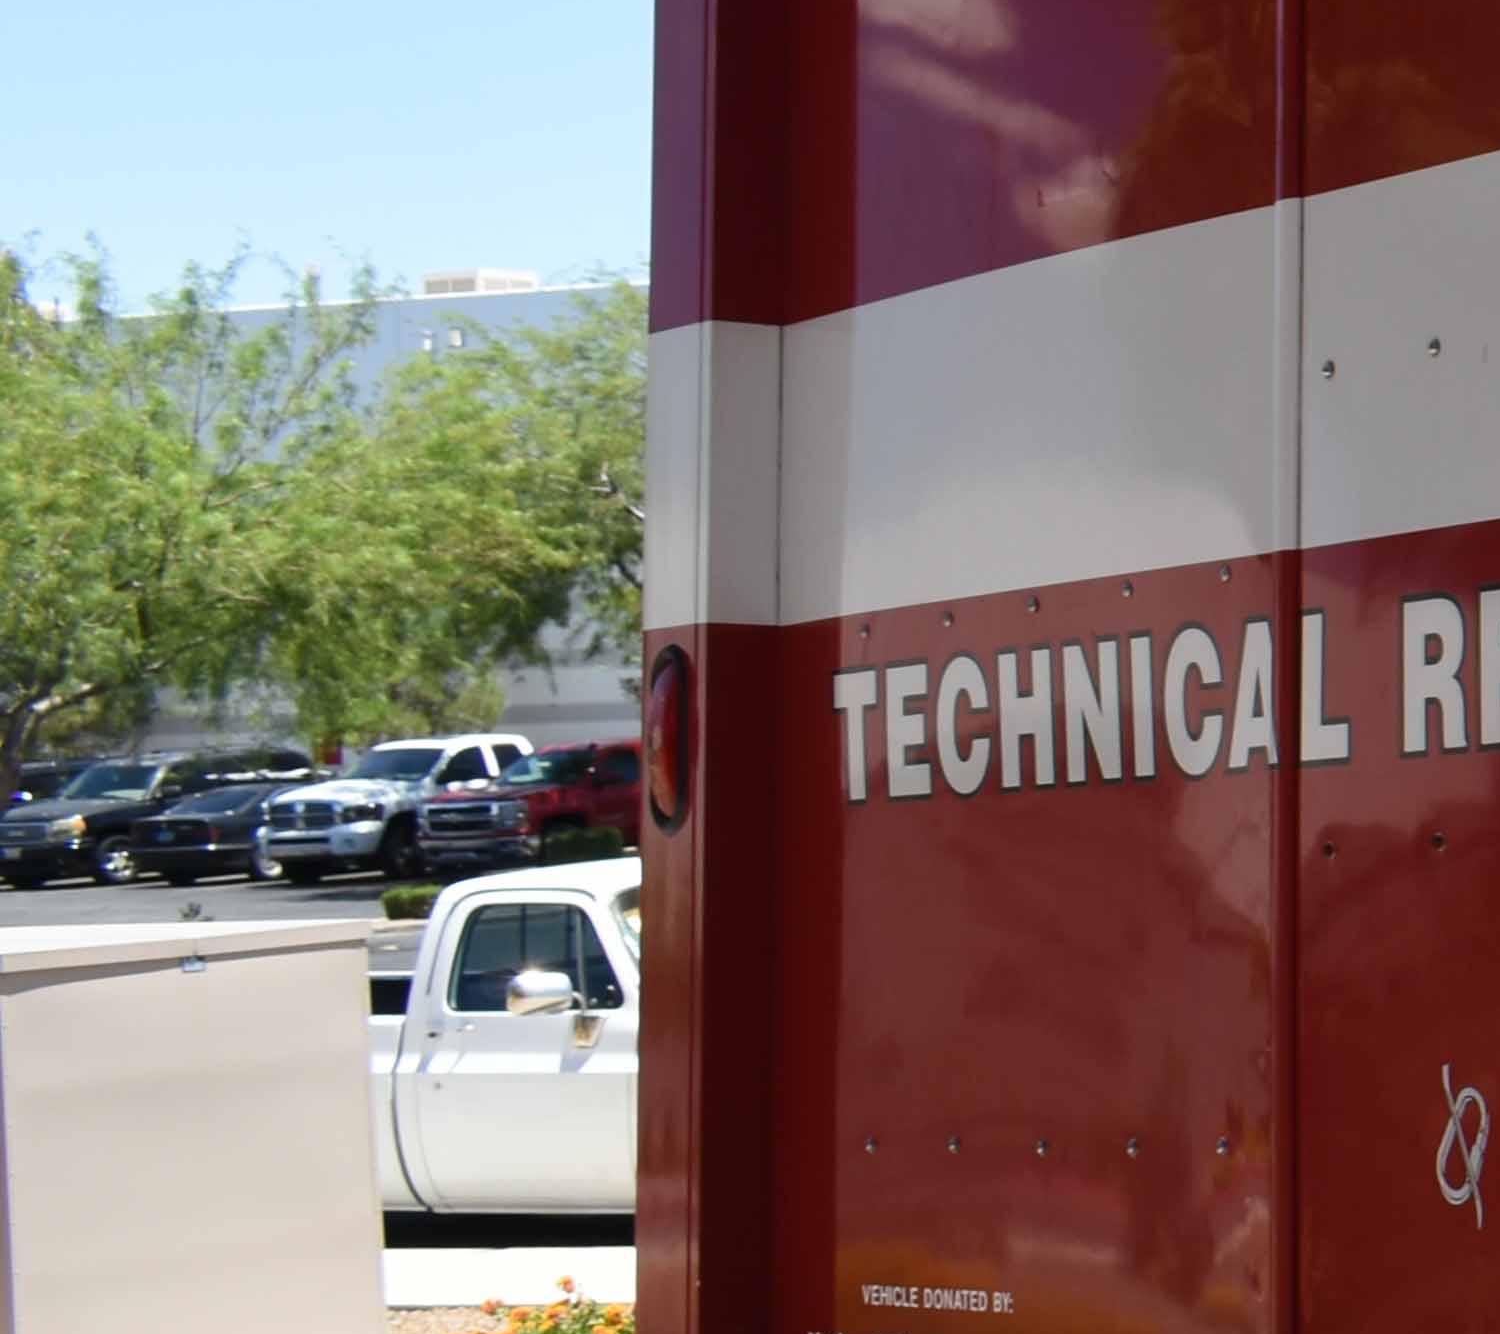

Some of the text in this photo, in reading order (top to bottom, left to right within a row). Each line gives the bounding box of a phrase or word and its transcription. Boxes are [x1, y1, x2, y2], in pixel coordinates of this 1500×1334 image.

[833, 609, 1350, 803] TECHNICAL
[861, 1284, 1014, 1313] VEHICLE DONATED BY:
